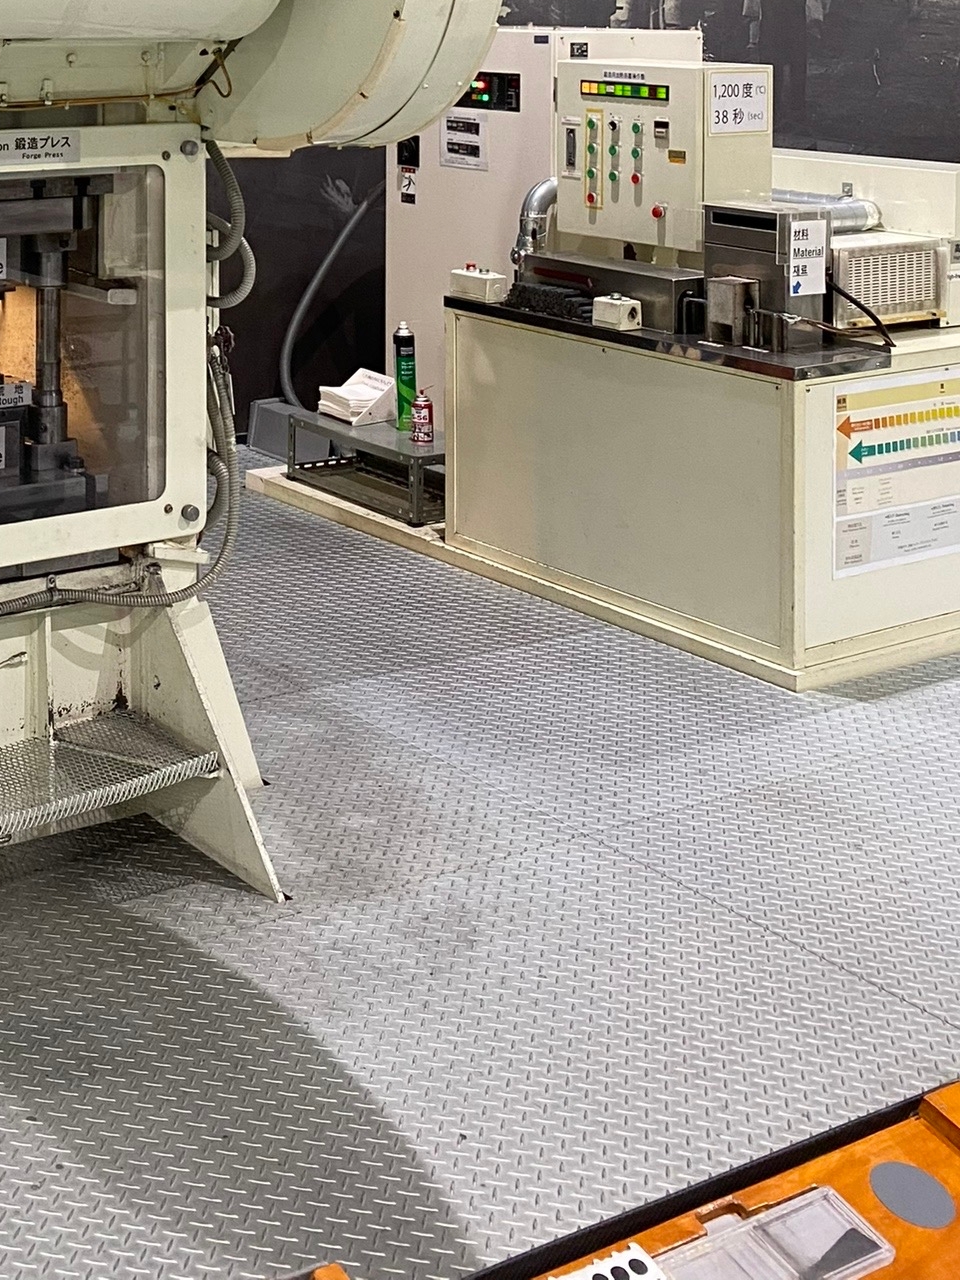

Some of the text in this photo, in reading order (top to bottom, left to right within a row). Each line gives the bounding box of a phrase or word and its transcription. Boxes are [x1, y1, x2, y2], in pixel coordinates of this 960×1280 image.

[713, 83, 740, 100] 1,200
[714, 109, 729, 125] 38
[747, 111, 764, 121] (sec)
[14, 135, 71, 151] 鍛造プレス
[22, 151, 64, 160] Forge Press
[793, 246, 824, 258] Material
